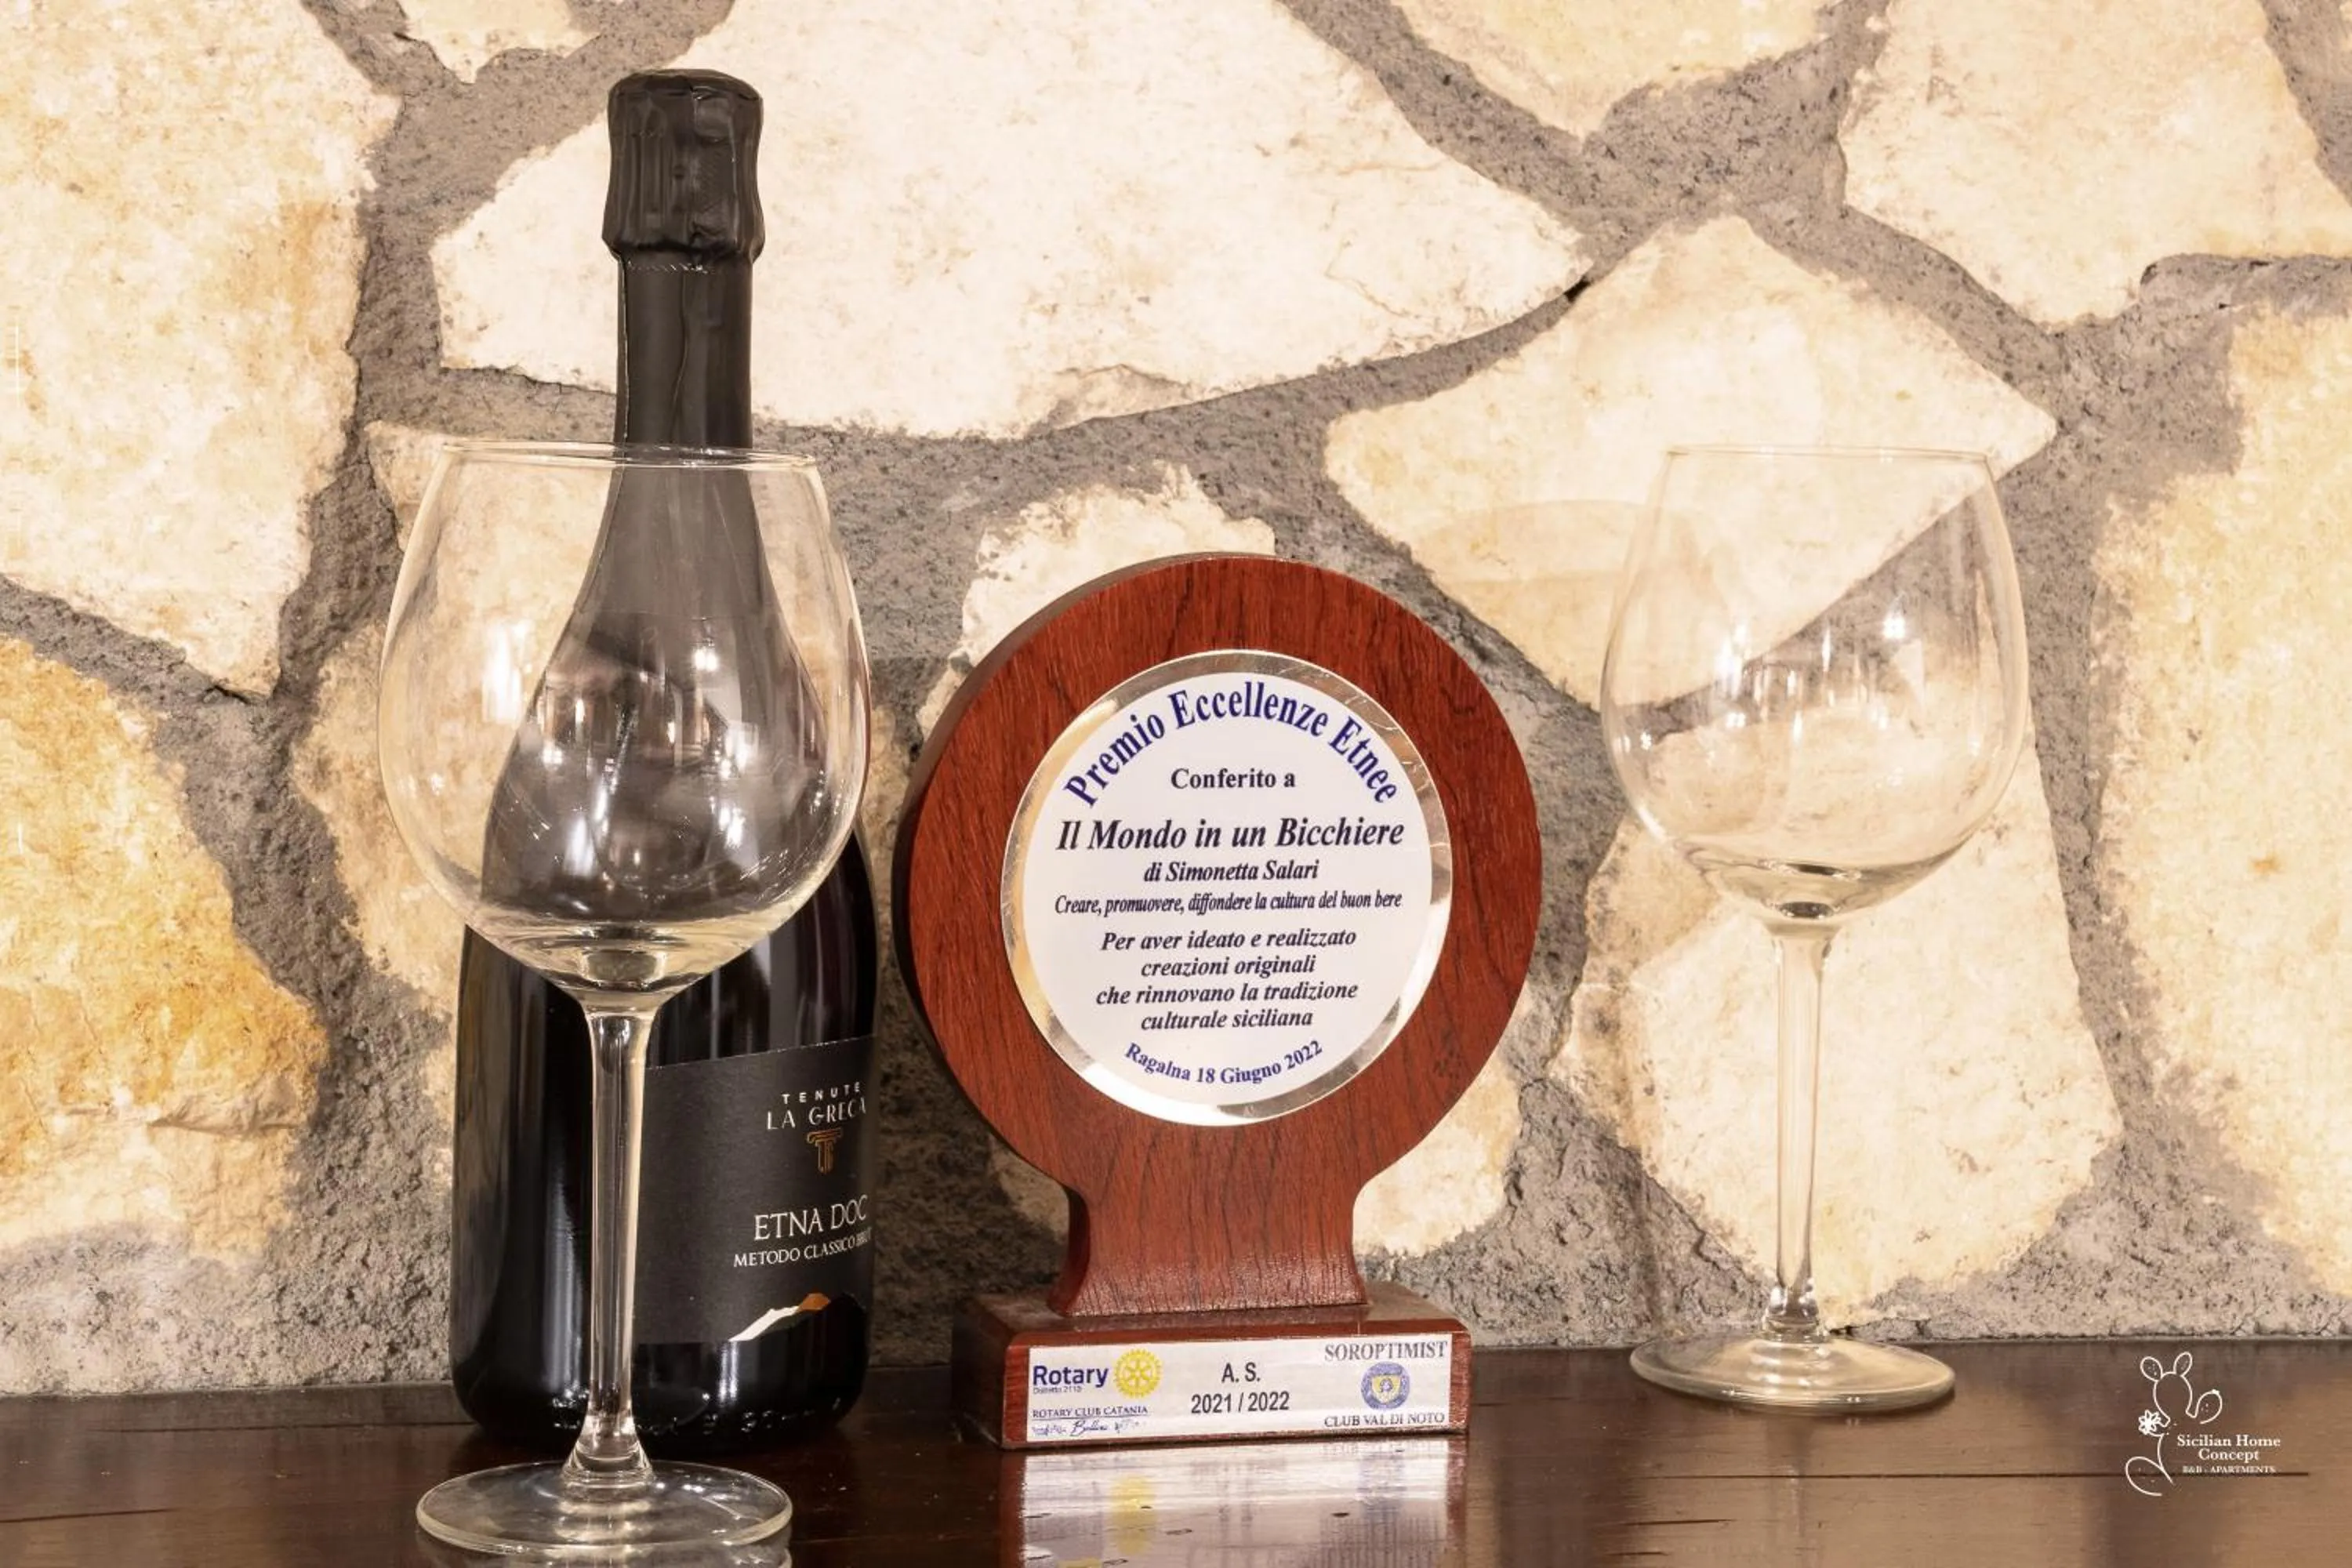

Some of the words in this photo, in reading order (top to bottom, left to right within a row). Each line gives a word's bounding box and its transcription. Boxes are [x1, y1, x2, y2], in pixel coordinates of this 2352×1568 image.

[1063, 713, 1166, 808] Premio
[1167, 681, 1329, 738] Eccellenze
[1329, 716, 1399, 804] Etnee
[1171, 767, 1277, 789] Conferito
[1283, 770, 1296, 787] a
[1055, 821, 1081, 850] Il
[1087, 818, 1187, 850] Mondo
[1194, 820, 1222, 848] in
[1231, 825, 1268, 847] un
[1276, 817, 1405, 847] Bicchiere
[1143, 862, 1162, 883] di
[1166, 859, 1258, 882] Simonetta
[1262, 858, 1319, 880] Salari
[1054, 895, 1102, 916] Creare,
[1103, 896, 1185, 917] promuovere,
[1188, 892, 1252, 916] diffondere
[1254, 891, 1267, 910] la
[1270, 891, 1315, 909] cultura
[1318, 890, 1338, 908] del
[1340, 890, 1370, 908] buon
[1374, 888, 1402, 908] bere
[1102, 931, 1135, 950] Per
[1140, 934, 1182, 949] aver
[1186, 930, 1246, 948] ideato
[1250, 933, 1261, 947] e
[1266, 928, 1357, 947] realizzato
[1141, 956, 1230, 977] creazioni
[1234, 954, 1316, 978] originali
[1096, 985, 1131, 1005] che
[1135, 985, 1235, 1004] rinnovano
[1240, 984, 1259, 1002] la
[1264, 980, 1359, 1001] tradizione
[1141, 1011, 1228, 1030] culturale
[1232, 1009, 1313, 1029] siciliana
[1124, 1042, 1191, 1080] Ragalna
[1197, 1067, 1216, 1083] 18
[1220, 1062, 1282, 1084] Giugno
[1284, 1040, 1323, 1069] 2022
[781, 1081, 860, 1104] TENUTE
[767, 1109, 796, 1131] LA
[808, 1097, 866, 1126] GRECA
[754, 1207, 824, 1240] ETNA
[831, 1194, 869, 1229] DOC
[733, 1247, 800, 1268] METODO
[804, 1235, 855, 1259] CLASSICO
[1325, 1341, 1447, 1361] SOROPTIMIST
[1033, 1365, 1109, 1388] Rotary
[1221, 1363, 1240, 1383] A.
[1244, 1362, 1261, 1382] S.
[1033, 1408, 1072, 1418] ROTARY
[1075, 1407, 1102, 1417] CLUB
[1104, 1405, 1148, 1415] CATANIA
[1191, 1394, 1232, 1414] 2021
[1248, 1391, 1290, 1411] 2022
[1324, 1415, 1360, 1428] CLUB
[1363, 1414, 1388, 1425] VAL
[1390, 1413, 1403, 1425] DI
[1407, 1412, 1445, 1424] NOTO
